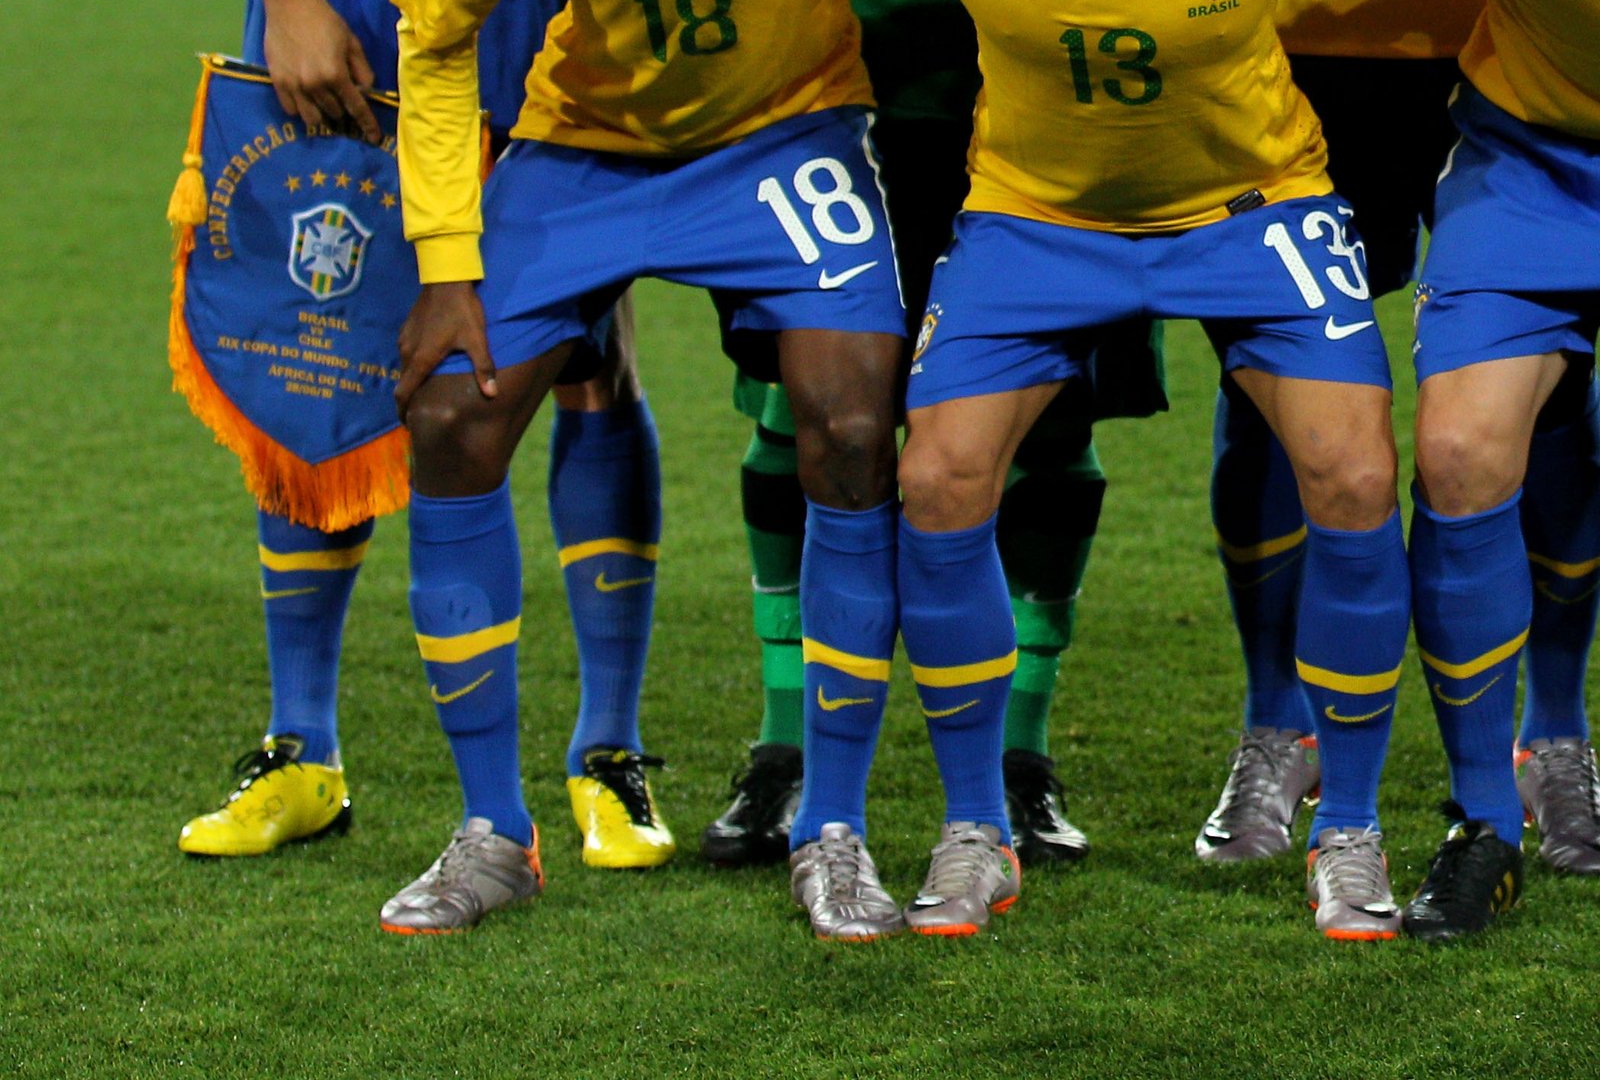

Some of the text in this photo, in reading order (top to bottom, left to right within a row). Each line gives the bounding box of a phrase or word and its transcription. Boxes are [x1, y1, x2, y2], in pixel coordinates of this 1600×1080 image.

[1059, 27, 1163, 106] 13
[756, 156, 875, 265] 18
[1263, 210, 1370, 310] 13
[298, 311, 349, 332] BRASIL
[242, 340, 278, 356] COPA
[281, 346, 299, 359] DO
[302, 350, 349, 369] MUNDO
[359, 362, 387, 379] FIFA
[299, 333, 333, 350] CHILE
[318, 373, 337, 387] DO
[339, 377, 364, 394] SUL
